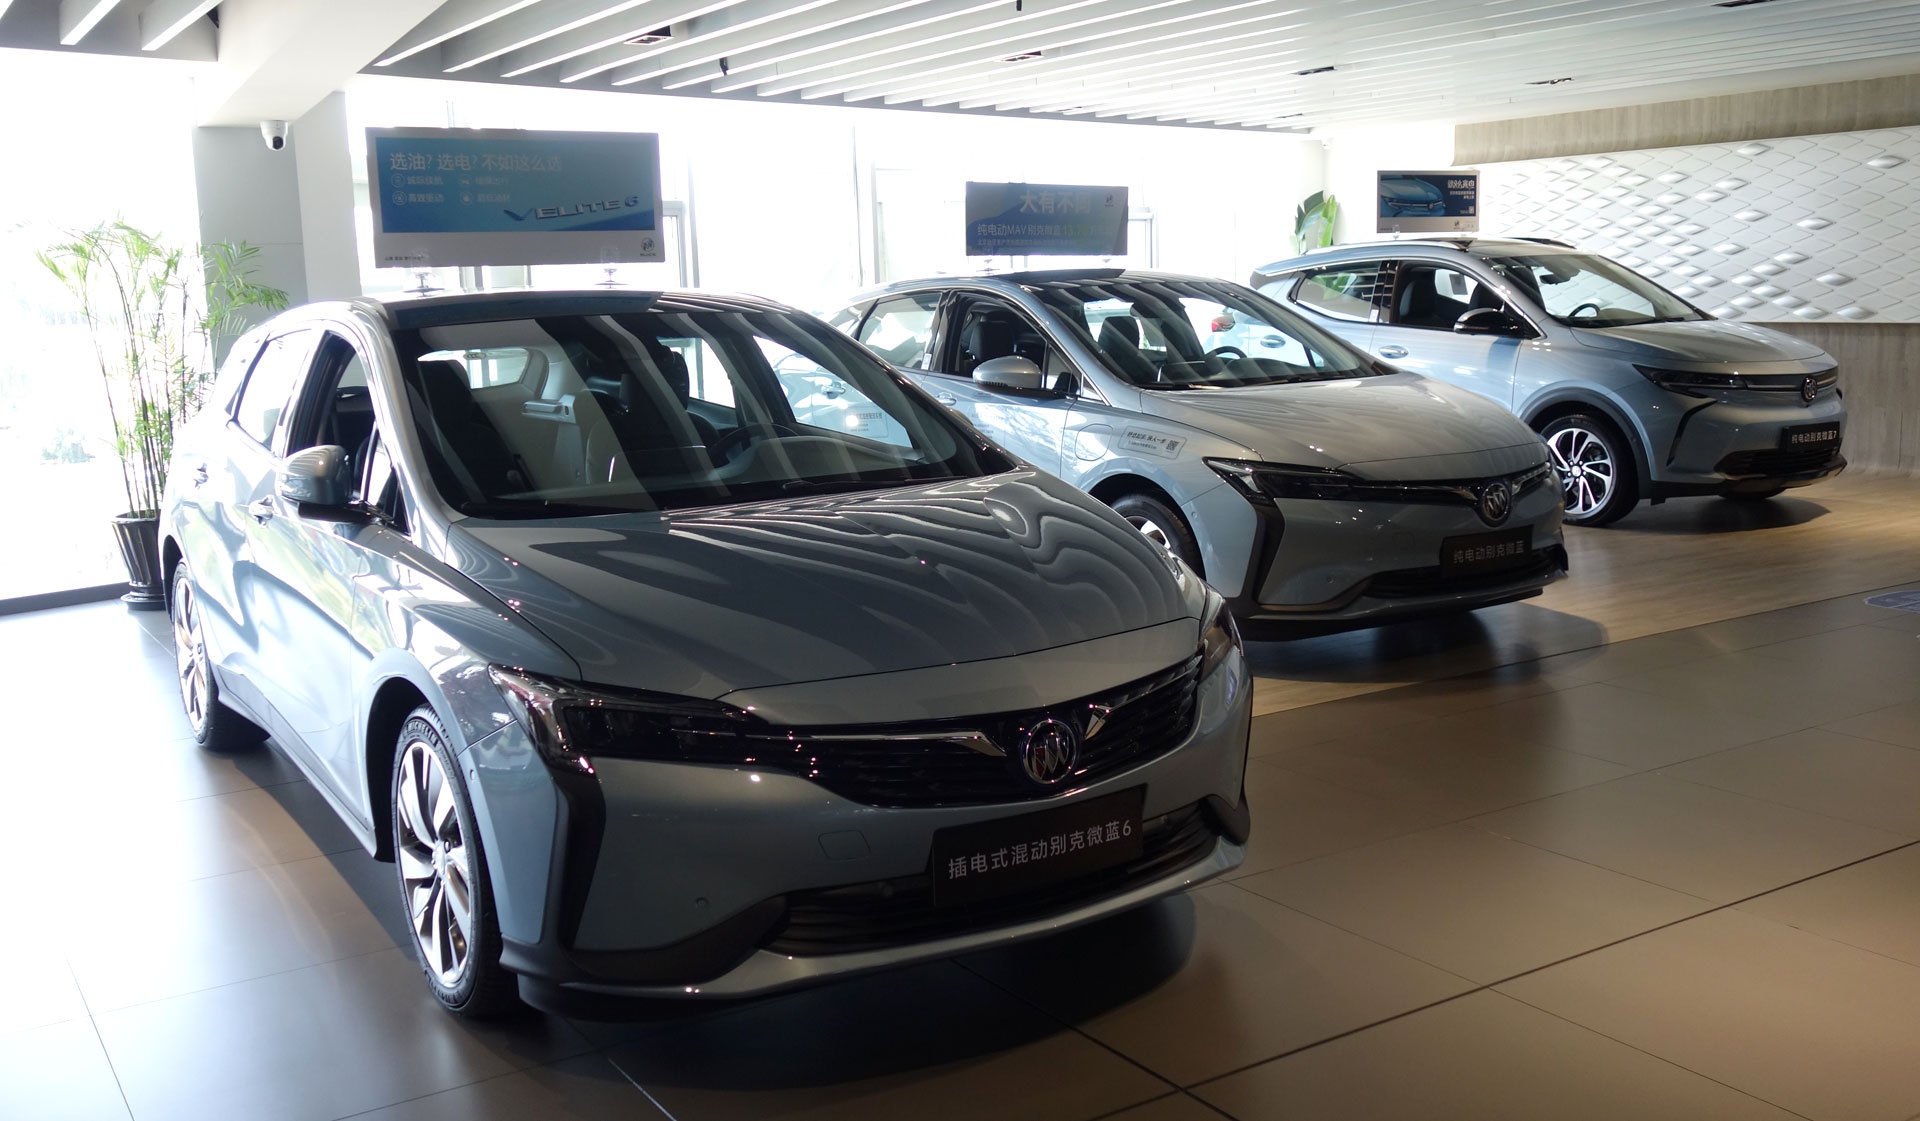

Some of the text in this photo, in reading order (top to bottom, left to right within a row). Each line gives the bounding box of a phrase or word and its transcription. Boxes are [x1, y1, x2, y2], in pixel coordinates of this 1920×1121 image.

[390, 152, 563, 172] 选油? 选电? 不如这么选
[503, 198, 621, 222] VELITE
[1453, 540, 1525, 564] 纯电动别克微蓝
[407, 720, 439, 748] MICHELIN
[948, 819, 1132, 880] 插电式混动别克微蓝6
